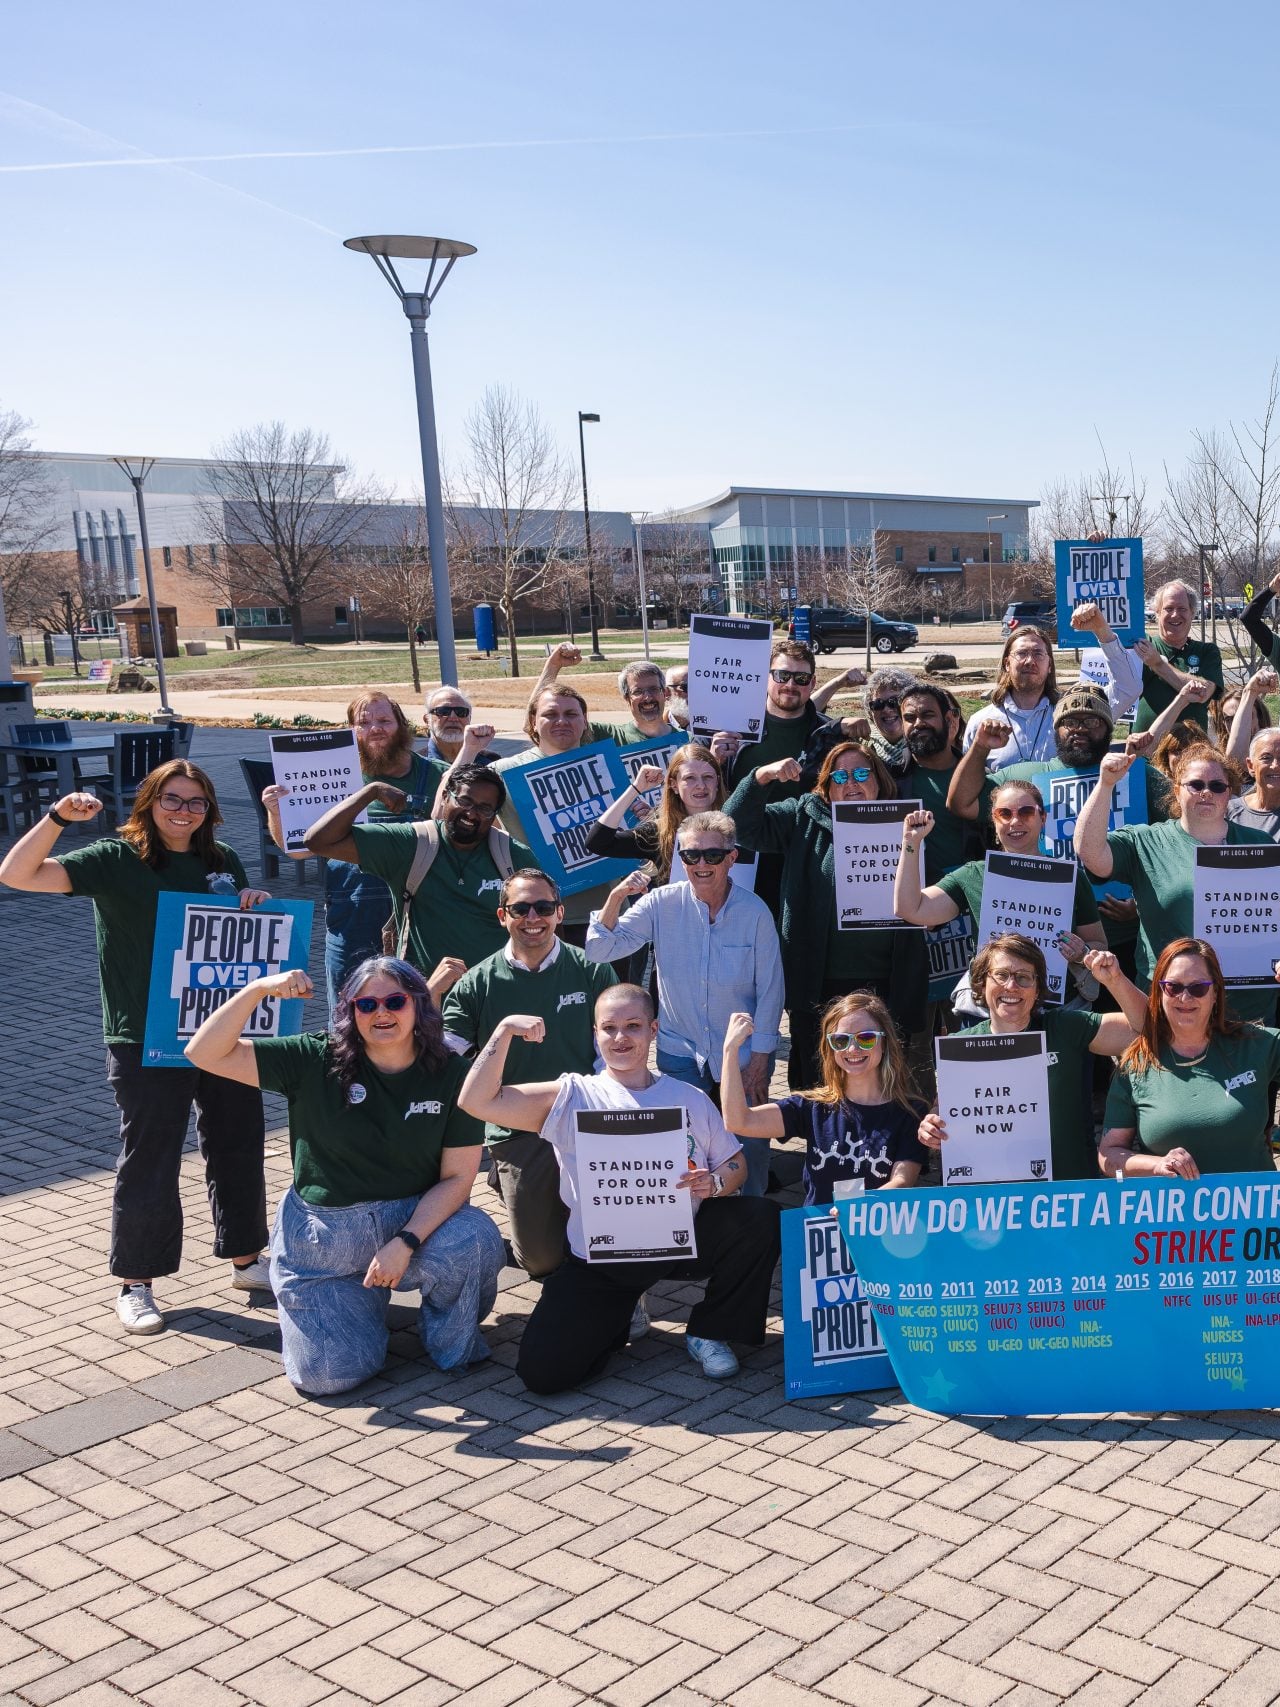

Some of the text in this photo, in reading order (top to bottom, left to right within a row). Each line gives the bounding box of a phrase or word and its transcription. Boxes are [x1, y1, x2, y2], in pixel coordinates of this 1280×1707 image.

[1073, 551, 1125, 582] PEOPLE
[1080, 582, 1116, 596] OVER
[715, 657, 742, 666] FAIR
[695, 670, 760, 682] CONTRACT
[712, 685, 740, 694] NOW
[285, 768, 351, 780] STANDING
[293, 781, 347, 792] FOR OUR
[531, 760, 609, 814] PEOPLE
[845, 843, 903, 854] STANDIN
[852, 859, 900, 868] FOR OU
[1020, 861, 1036, 869] LOCAL
[847, 874, 896, 882] STUDEN
[1205, 892, 1279, 901] STANDING
[992, 900, 1062, 916] STANDING
[1212, 908, 1272, 917] FOR OUR
[997, 916, 1054, 932] FOR OUR
[1205, 924, 1278, 933] STUDENTS
[186, 915, 283, 964] PEOPLE
[975, 1087, 1011, 1098] FAIR
[950, 1103, 1038, 1117] CONTRACT
[976, 1122, 1013, 1134] NOW
[589, 1160, 674, 1171] STANDING
[598, 1178, 668, 1188] FOR OUR
[593, 1195, 676, 1205] STUDENTS
[849, 1201, 921, 1236] HOW
[927, 1199, 966, 1233] DO
[976, 1196, 1023, 1230] WE
[1030, 1194, 1085, 1227] GET
[1091, 1193, 1114, 1226] A
[1119, 1190, 1185, 1225] FAIR
[1133, 1227, 1236, 1266] STRIKE
[899, 1283, 933, 1297] 2010
[941, 1281, 975, 1297] 2011
[984, 1279, 1019, 1295] 2012
[1028, 1278, 1062, 1293] 2013
[1071, 1275, 1106, 1291] 2014
[1115, 1274, 1150, 1288] 2015
[1159, 1272, 1194, 1287] 2016
[1202, 1270, 1237, 1286] 2017
[1246, 1269, 1280, 1284] 2018
[1073, 1299, 1106, 1312] UICUF
[1164, 1295, 1191, 1308] NTFC
[898, 1306, 937, 1317] UIC-GEO
[984, 1303, 1022, 1315] SEIU73
[990, 1317, 1017, 1332] (UIC)
[1080, 1321, 1102, 1333] INA-
[901, 1326, 937, 1338] SEIU73
[908, 1340, 934, 1354] (UIC)
[987, 1339, 1023, 1351] UI-GEO
[1072, 1335, 1112, 1348] NURSES
